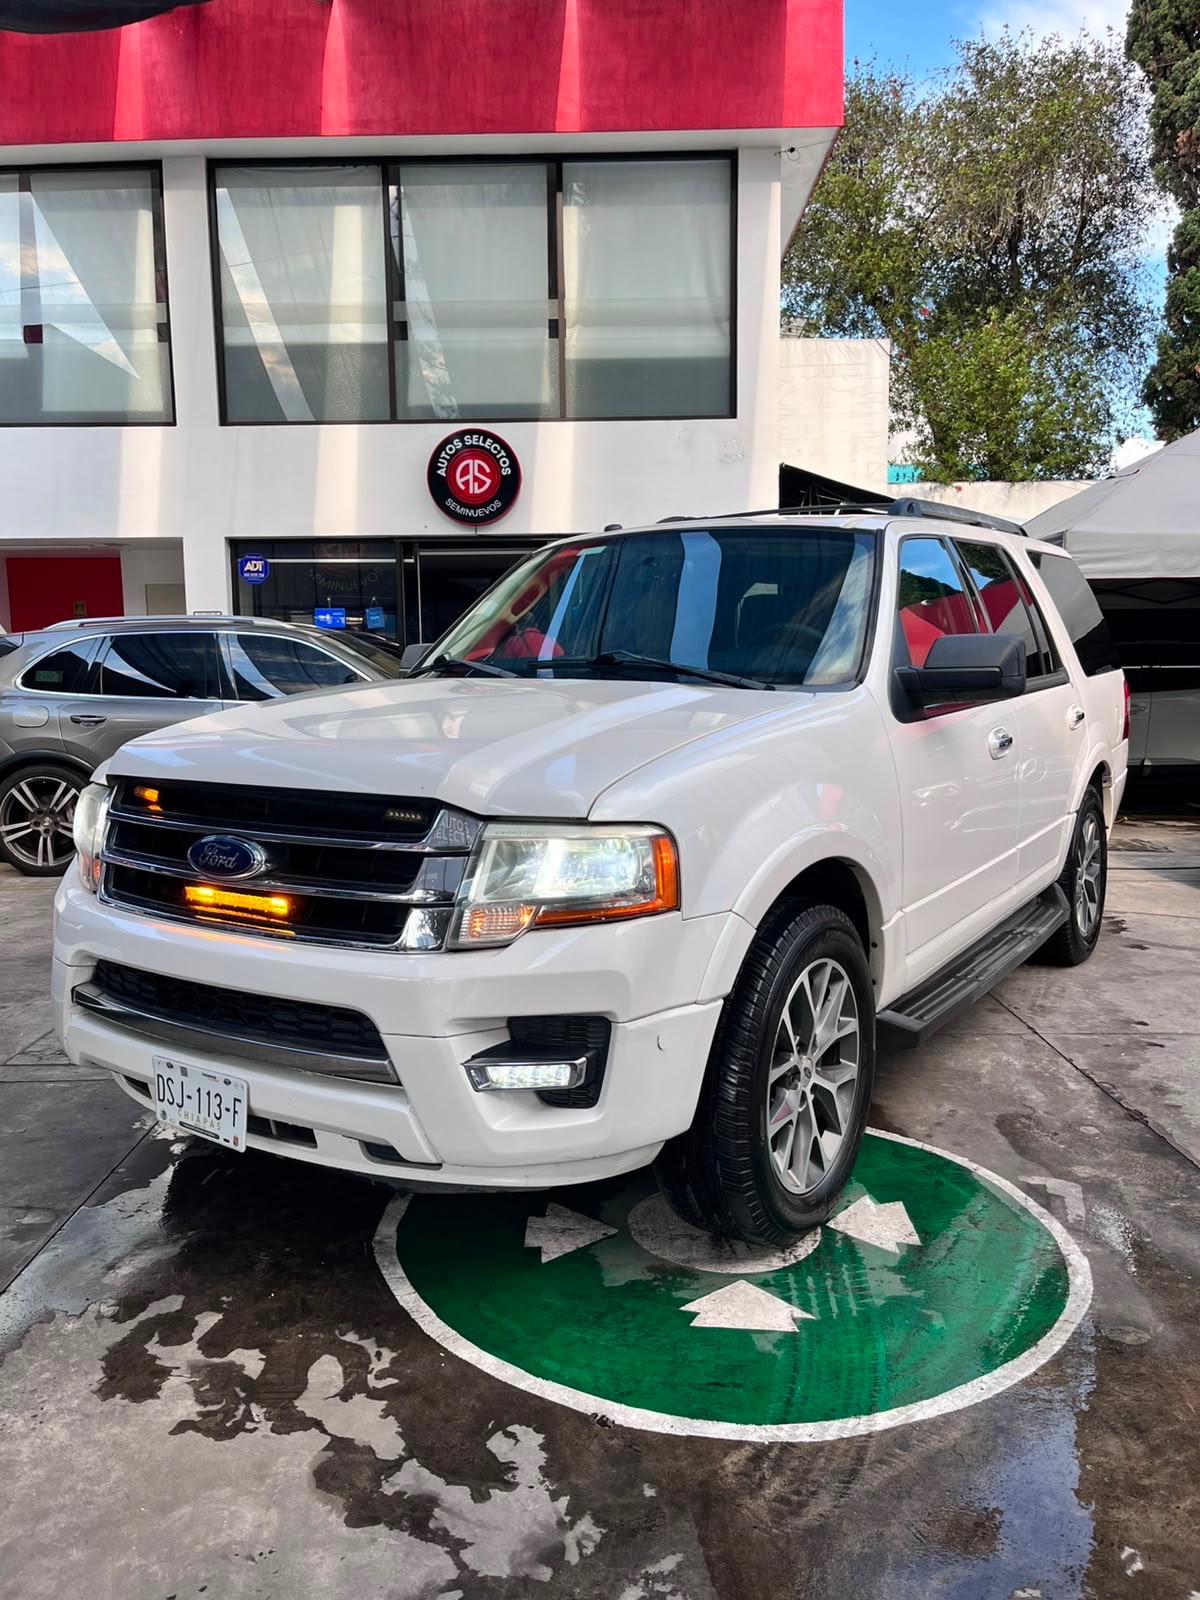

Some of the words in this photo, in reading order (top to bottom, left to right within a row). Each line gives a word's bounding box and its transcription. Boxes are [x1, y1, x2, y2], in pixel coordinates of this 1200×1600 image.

[436, 438, 463, 477] AUTOS
[464, 435, 512, 476] SELECTOS
[456, 459, 492, 494] AS
[445, 498, 502, 517] SEMINUEVOS
[244, 560, 265, 571] ADT
[199, 843, 240, 869] Ford
[157, 1074, 241, 1127] DSJ-113-F
[178, 1109, 221, 1131] CHIAPAS
